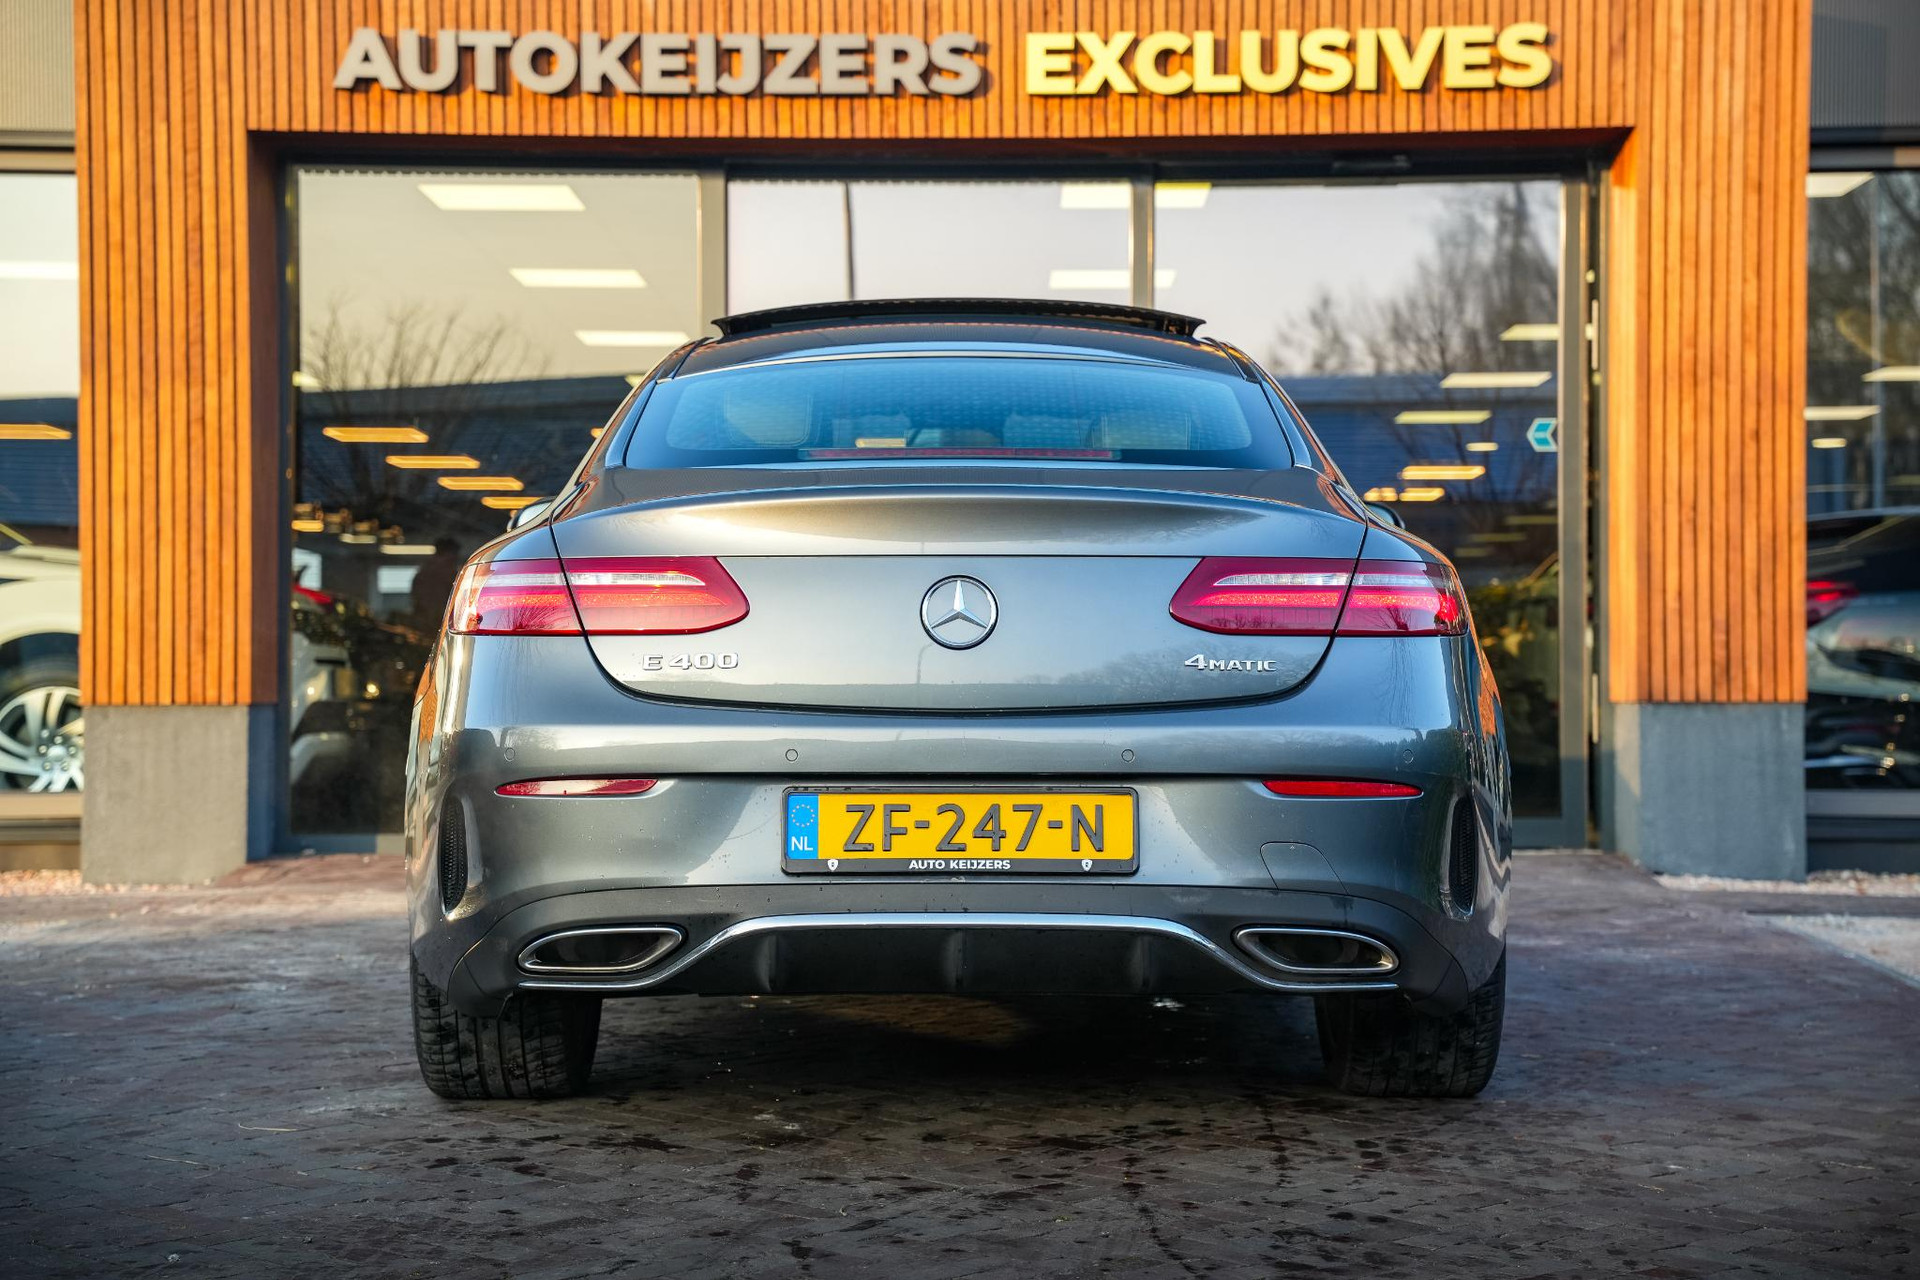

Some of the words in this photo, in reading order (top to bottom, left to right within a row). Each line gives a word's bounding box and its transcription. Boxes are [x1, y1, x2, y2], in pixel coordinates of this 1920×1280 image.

[333, 27, 981, 95] AUTOKEIJZERS
[1025, 22, 1553, 95] EXCLUSIVES
[642, 654, 663, 671] E
[669, 652, 739, 670] 400
[1184, 653, 1277, 671] 4MATIC
[842, 803, 1105, 852] ZF-247-N
[790, 836, 814, 852] NL
[908, 859, 947, 870] AUTO
[950, 859, 1011, 870] KEIJZERS
